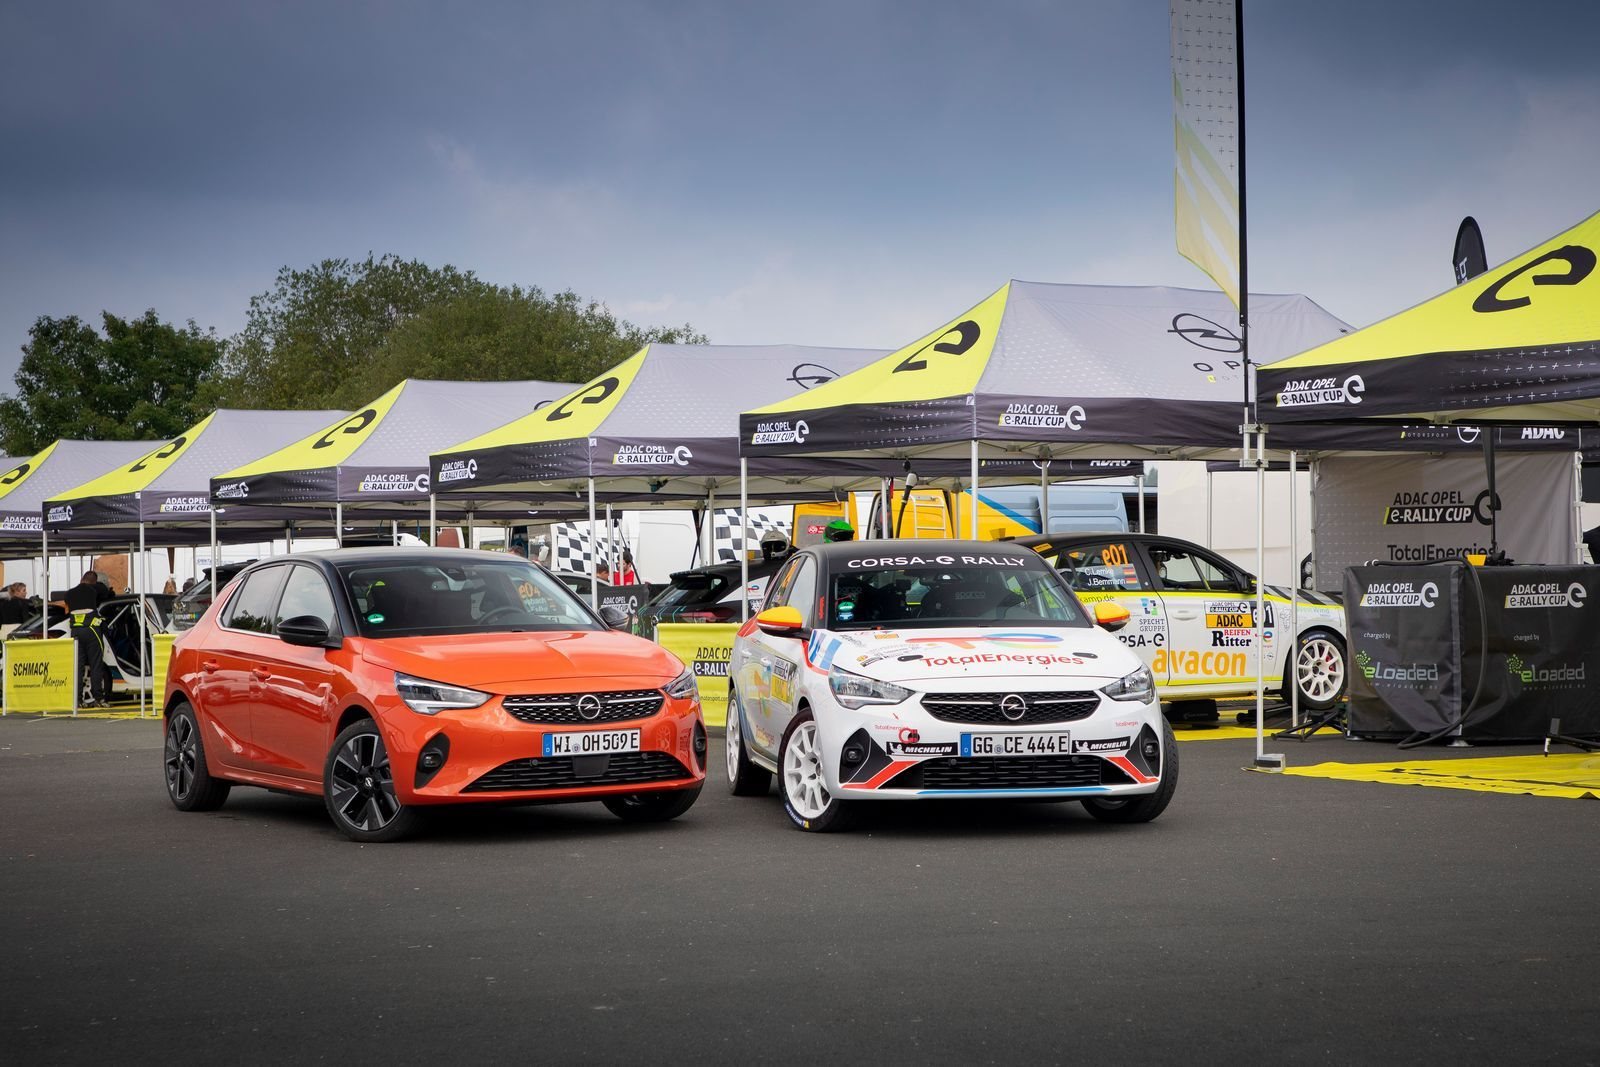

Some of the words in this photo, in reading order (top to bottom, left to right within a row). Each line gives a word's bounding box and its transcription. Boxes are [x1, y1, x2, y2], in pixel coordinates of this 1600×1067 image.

[1283, 379, 1310, 392] ADAC
[1312, 377, 1336, 389] OPEL
[1281, 392, 1320, 405] e-RALLY
[1323, 390, 1343, 402] CUP
[1006, 403, 1034, 414] ADAC
[1035, 404, 1060, 415] OPEL
[757, 422, 774, 432] ADAC
[774, 421, 791, 431] OPEL
[1004, 415, 1044, 426] e-RALLY
[1045, 416, 1065, 427] CUP
[755, 433, 780, 443] e-RALLY
[780, 432, 795, 442] CUP
[1521, 427, 1565, 440] ADAC
[618, 445, 643, 454] ADAC
[645, 445, 668, 454] OPEL
[617, 453, 653, 464] e-RALLY
[654, 454, 673, 464] CUP
[441, 463, 454, 471] ADAC
[454, 461, 465, 470] OPEL
[364, 474, 388, 482] ADAC
[388, 474, 409, 482] OPEL
[458, 469, 469, 479] CUP
[397, 483, 414, 491] CUP
[1393, 491, 1429, 506] ADAC
[1431, 490, 1465, 505] OPEL
[1390, 507, 1444, 523] e-RALLY
[1445, 506, 1472, 522] CUP
[960, 555, 1025, 567] RALLY
[1102, 543, 1129, 567] e01
[1367, 583, 1391, 594] ADAC
[1392, 582, 1414, 593] OPEL
[1510, 584, 1536, 595] ADAC
[1537, 583, 1561, 594] OPEL
[1366, 594, 1401, 605] e-RALLY
[1401, 595, 1420, 606] CUP
[1509, 596, 1548, 607] e-RALLY
[1549, 596, 1567, 606] CUP
[1216, 614, 1243, 628] ADAC
[1211, 630, 1252, 647] Ritter
[1363, 632, 1384, 640] charged
[695, 647, 720, 659] ADAC
[921, 653, 1085, 667] TotalEnergies
[1152, 649, 1247, 676] avacon
[13, 661, 50, 676] SCHMACK
[553, 735, 571, 754] WI
[904, 745, 953, 754] MICHELIN
[973, 736, 993, 754] GG
[1004, 736, 1024, 753] CE
[1090, 740, 1128, 750] MICHELIN
